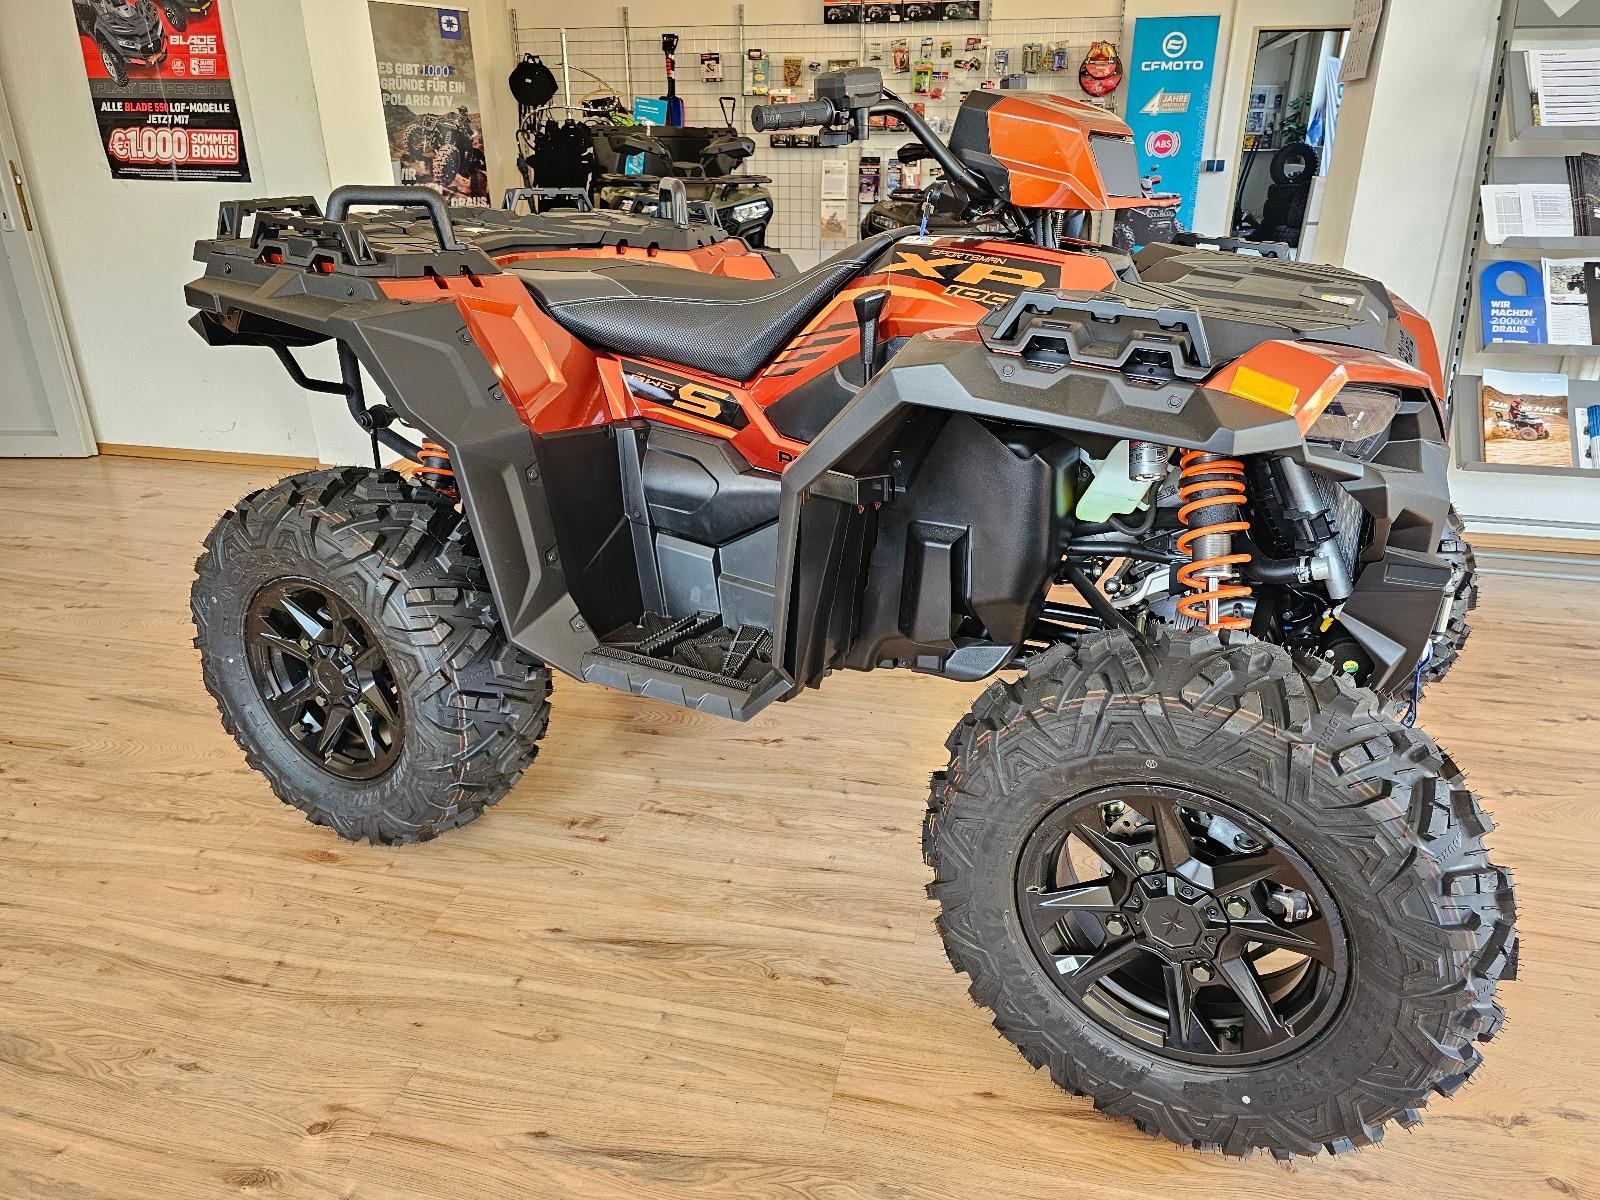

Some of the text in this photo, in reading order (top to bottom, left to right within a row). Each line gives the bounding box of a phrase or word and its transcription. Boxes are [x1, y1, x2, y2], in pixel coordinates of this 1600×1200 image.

[170, 35, 217, 45] BLADE
[190, 45, 217, 54] 550
[377, 62, 393, 75] ES
[395, 63, 419, 76] GIBT
[1141, 61, 1204, 71] CFMOTO
[94, 83, 229, 95] PLAY DIFFERENT
[381, 75, 465, 93] GRÜNDE FÜR EIN
[383, 93, 430, 106] POLARIS
[1161, 94, 1188, 103] JAHRE
[101, 102, 230, 113] ALLE BLADE 550 LOF-MODELLE
[147, 114, 189, 124] JETZT MIT
[191, 133, 234, 144] SOMMER
[1154, 140, 1172, 148] ABS
[192, 145, 236, 159] BONUS
[928, 248, 1007, 265] SPORTSMAN
[875, 251, 1046, 288] XP
[1491, 300, 1511, 308] WIR
[1491, 309, 1533, 317] MACHEN
[672, 382, 729, 419] S
